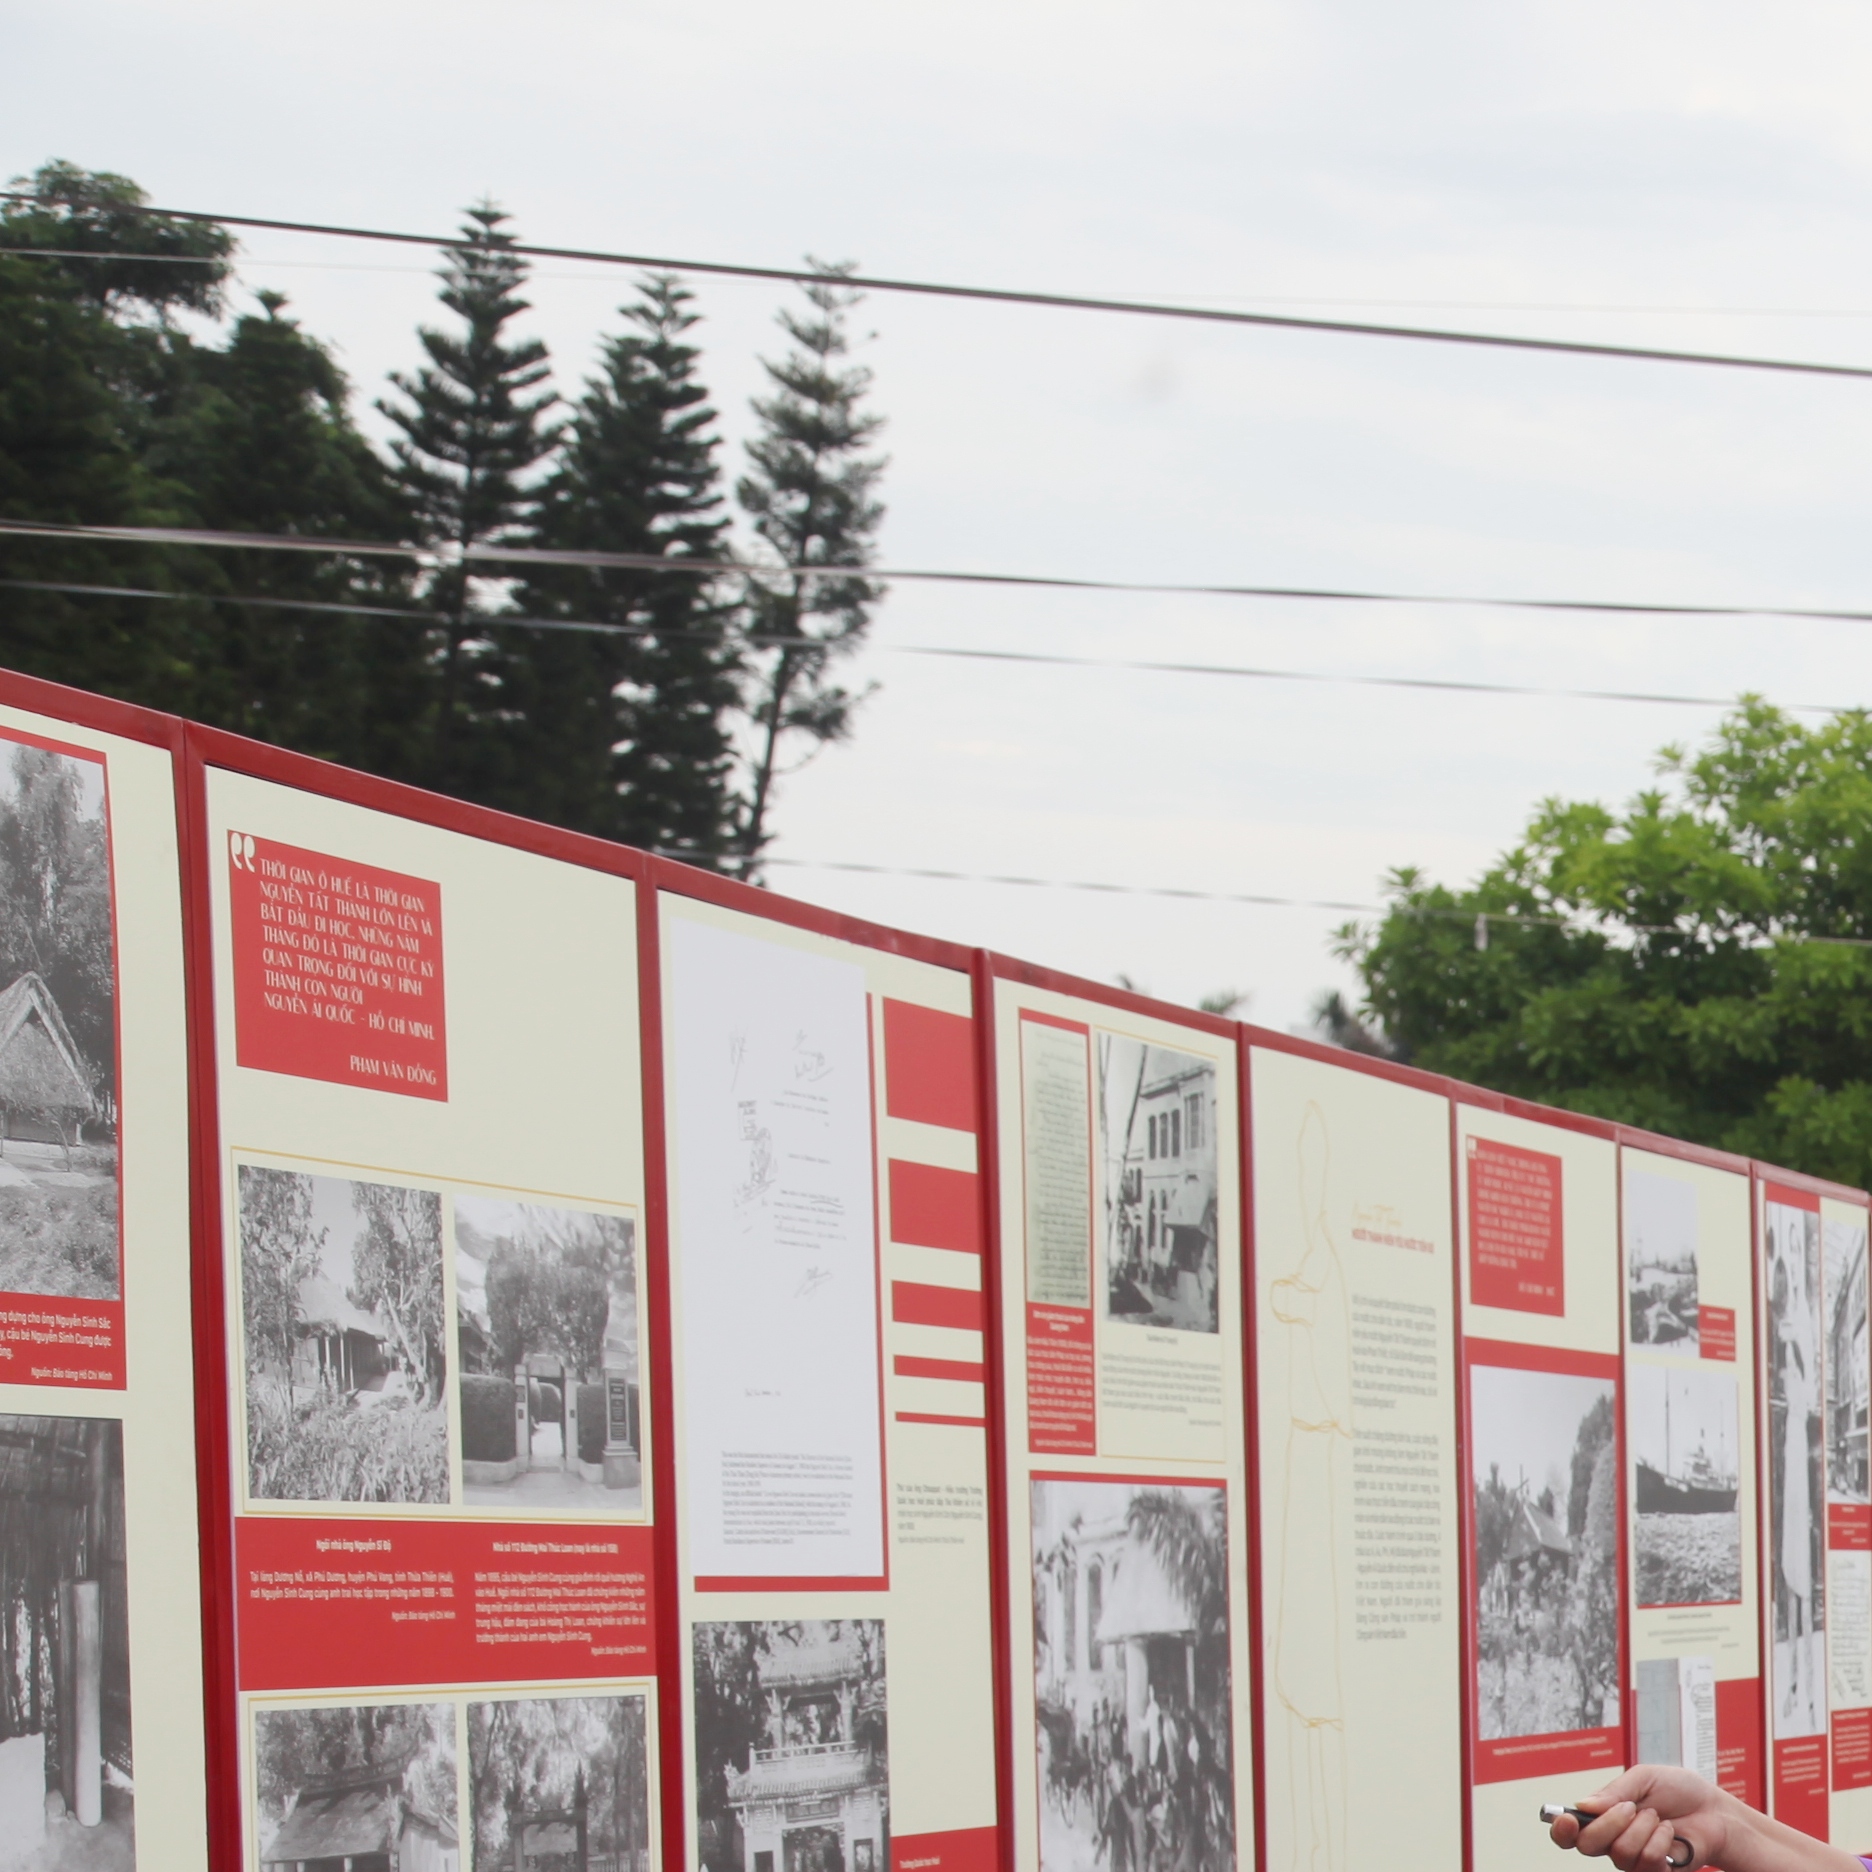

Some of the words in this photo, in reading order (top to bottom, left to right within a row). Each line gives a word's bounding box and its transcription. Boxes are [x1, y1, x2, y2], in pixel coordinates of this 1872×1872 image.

[259, 881, 304, 905] NGUYỄN
[308, 888, 330, 912] TẤT
[334, 898, 370, 921] THÀNH
[373, 906, 395, 927] LỚN
[398, 911, 418, 932] LÊN
[421, 916, 433, 936] VÀ
[260, 859, 286, 880] THỜI
[290, 866, 315, 886] GIAN
[331, 873, 352, 895] HUẾ
[356, 879, 370, 899] LÀ
[374, 885, 398, 906] THỜI
[401, 892, 425, 912] GIAN
[261, 900, 283, 924] BẮT
[288, 906, 311, 930] ĐẦU
[315, 917, 327, 933] ĐI
[358, 925, 394, 948] NHỮNG
[396, 931, 420, 953] NĂM
[263, 925, 299, 948] THÁNG
[303, 933, 320, 952] ĐÓ
[323, 937, 338, 956] LÀ
[342, 942, 366, 963] THỜI
[369, 949, 394, 968] GIAN
[397, 955, 417, 976] CỰC
[262, 949, 293, 969] QUAN
[297, 956, 334, 979] TRỌNG
[337, 960, 356, 982] ĐỐI
[360, 966, 378, 987] VỚI
[381, 973, 397, 994] SỰ
[398, 973, 422, 995] HÌNH
[264, 969, 301, 991] THÀNH
[304, 978, 327, 996] CON
[331, 983, 364, 1004] NGƯỜI
[263, 992, 308, 1015] NGUYỄN
[312, 998, 322, 1019] ÁI
[326, 1001, 356, 1024] QUỐC
[369, 1008, 385, 1030] HỒ
[388, 1014, 405, 1034] CHÍ
[350, 1055, 379, 1077] PHẠM
[383, 1058, 404, 1079] VĂN
[407, 1060, 437, 1085] ĐỒNG
